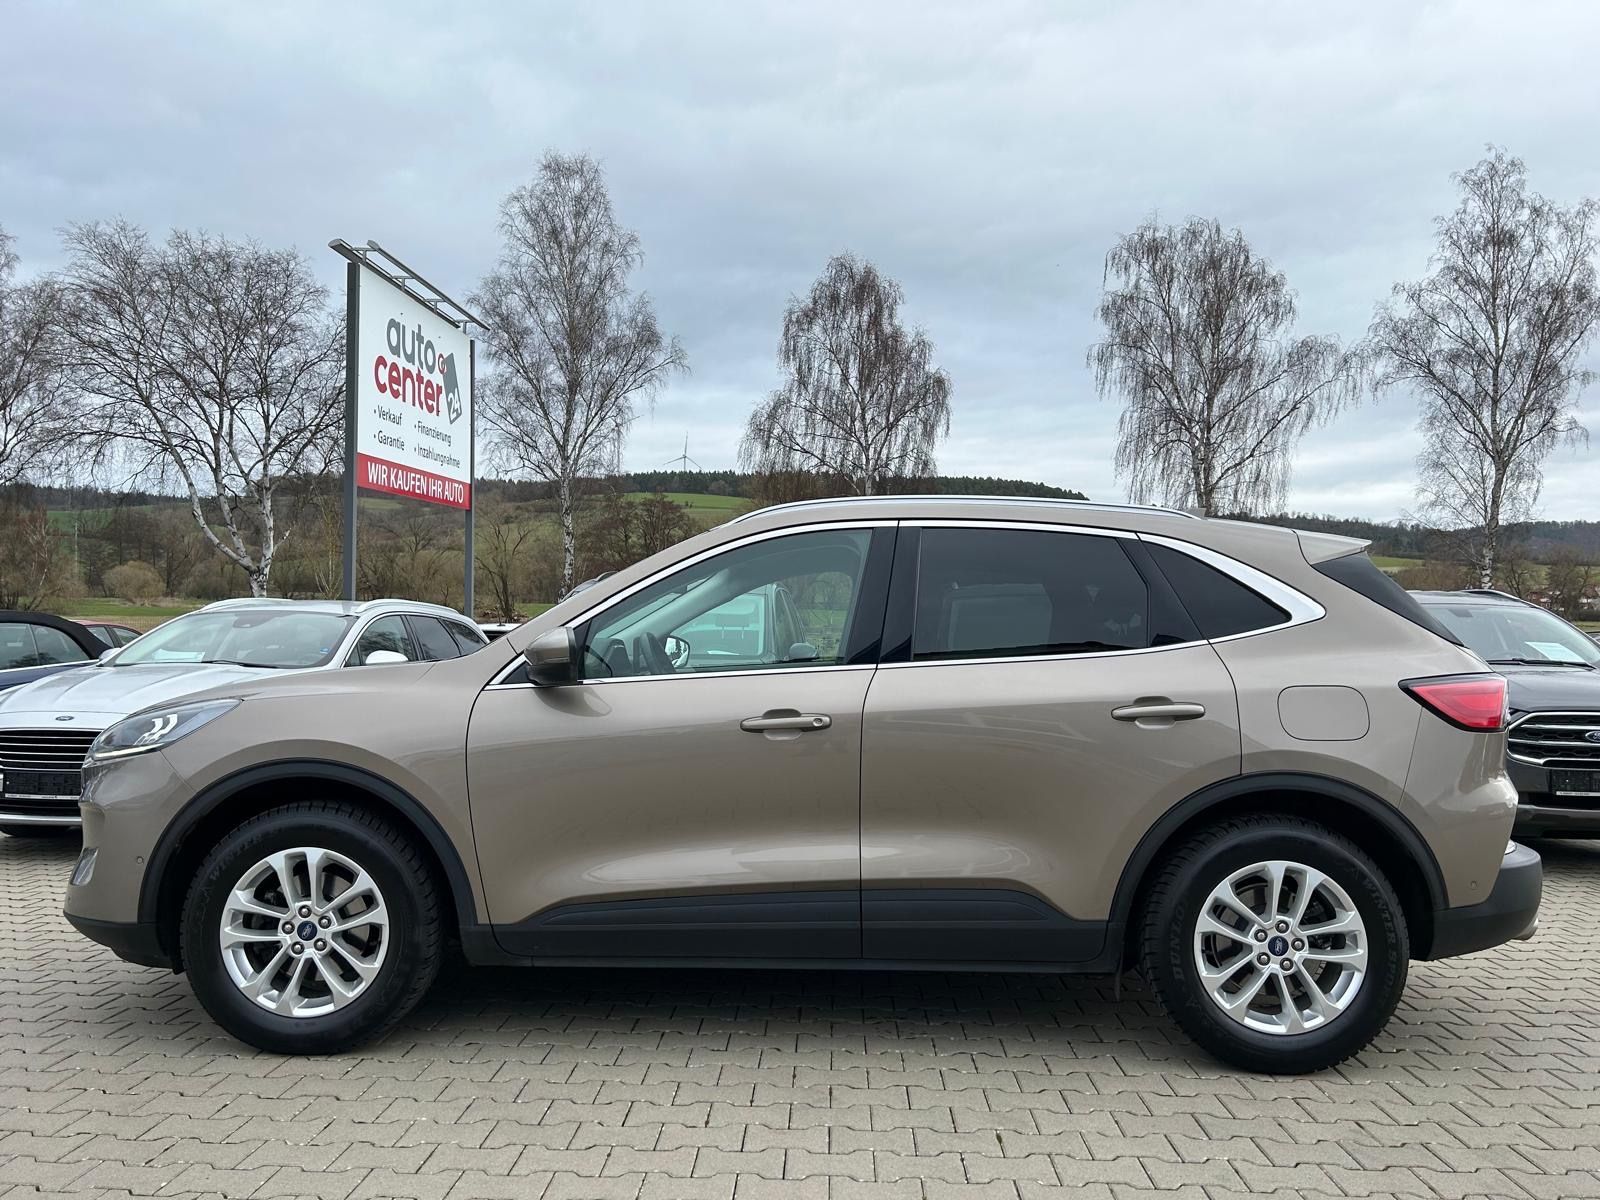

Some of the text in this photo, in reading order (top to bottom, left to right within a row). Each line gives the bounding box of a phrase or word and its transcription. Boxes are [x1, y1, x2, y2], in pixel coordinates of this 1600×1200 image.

[386, 318, 436, 375] auto
[374, 355, 443, 416] center
[377, 405, 403, 427] Verkauf
[447, 387, 462, 420] 24
[377, 430, 405, 451] Garantie
[417, 420, 452, 447] Finanzierung
[417, 443, 460, 469] Inzahlungnahme
[367, 461, 464, 504] WIR KAUFEN IHR AUTO
[1169, 897, 1187, 981] DUNLO
